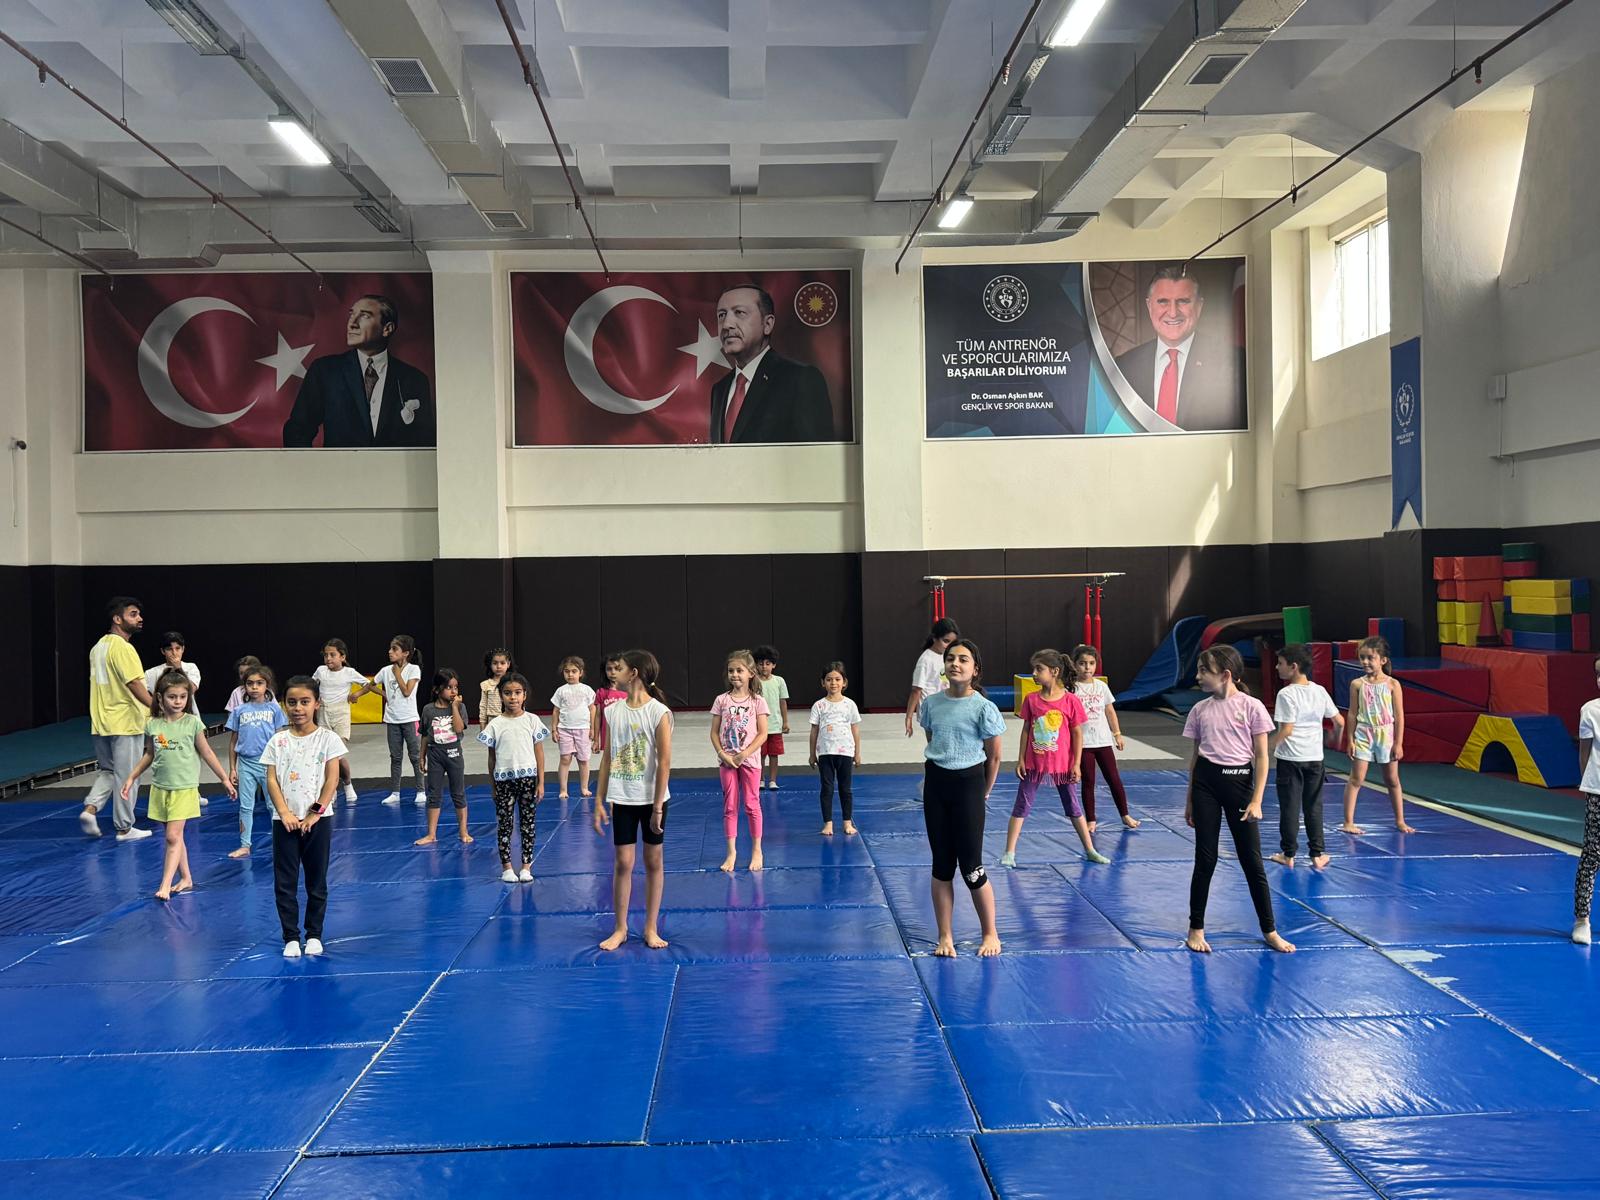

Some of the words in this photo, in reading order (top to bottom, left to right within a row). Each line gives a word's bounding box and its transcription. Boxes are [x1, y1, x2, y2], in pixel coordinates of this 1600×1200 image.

[956, 338, 985, 352] TÜM
[988, 337, 1057, 351] ANTRENÖR
[942, 353, 958, 365] VE
[960, 351, 1071, 365] SPORCULARIMIZA
[947, 366, 1006, 379] BAŞARILAR
[1007, 365, 1067, 377] DİLİYORUM
[1007, 392, 1028, 401] Aşkın
[961, 402, 993, 412] GENÇLİK
[993, 402, 1003, 410] VE
[1004, 402, 1025, 410] SPOR
[1025, 401, 1054, 409] BAKANI
